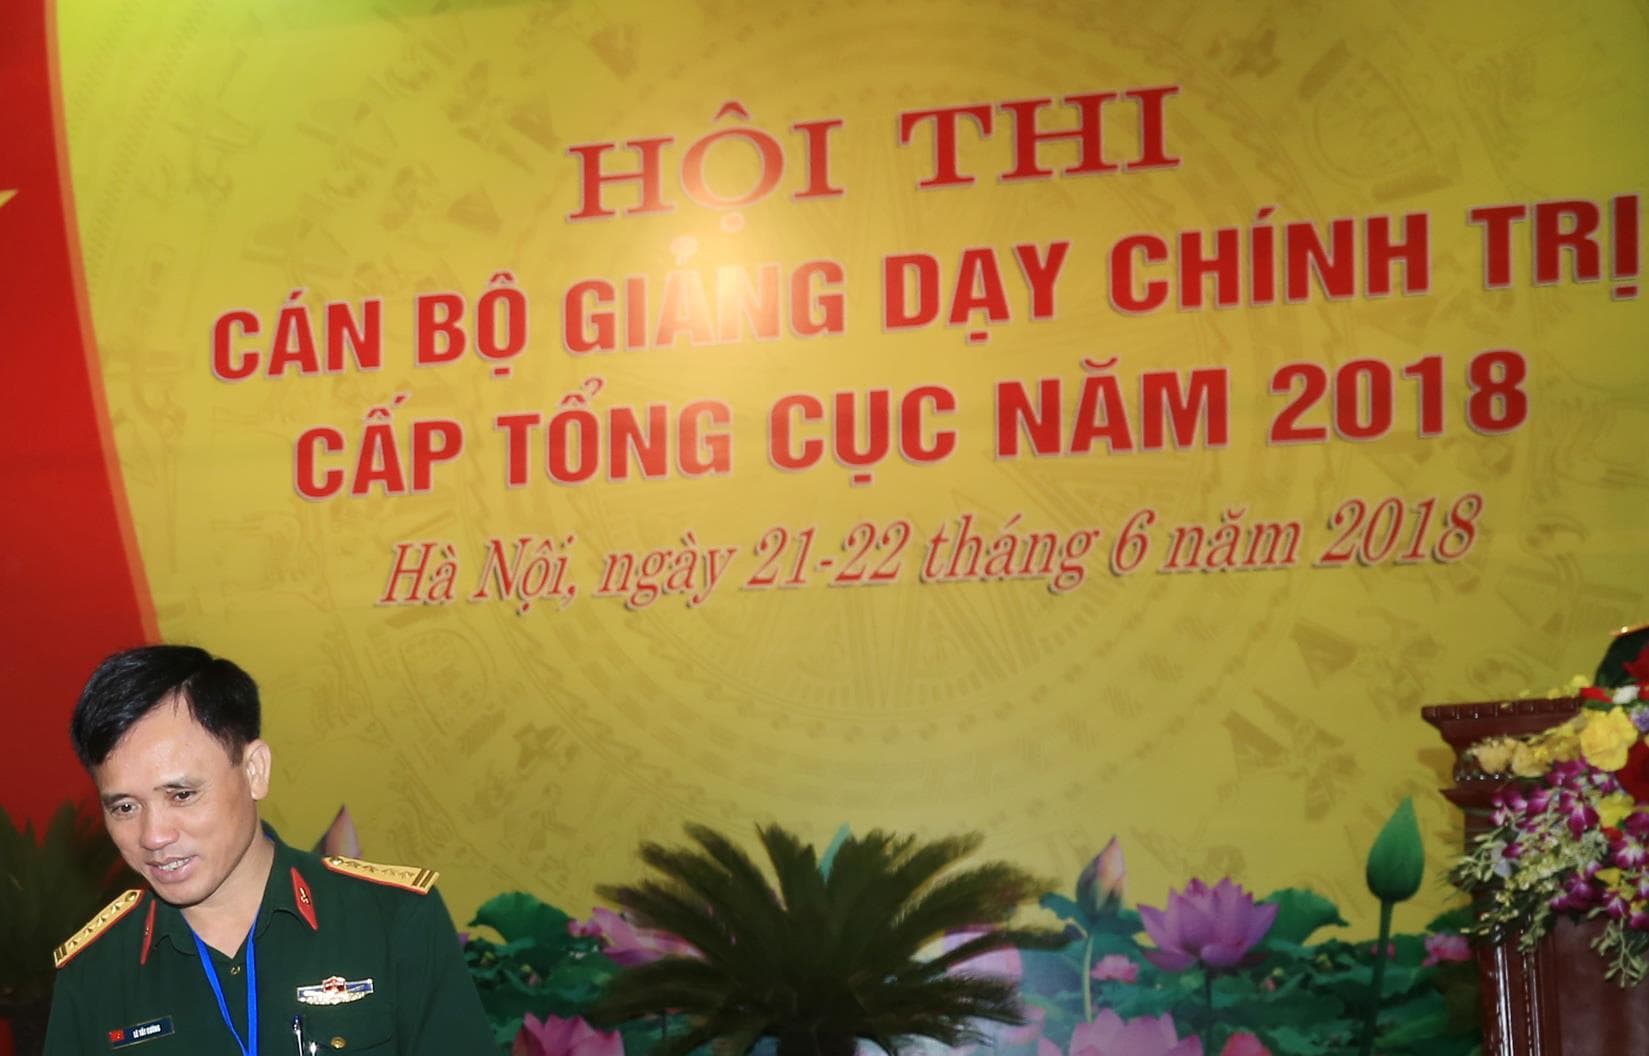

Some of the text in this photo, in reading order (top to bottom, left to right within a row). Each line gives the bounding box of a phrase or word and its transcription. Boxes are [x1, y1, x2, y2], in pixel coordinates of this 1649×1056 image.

[566, 85, 1180, 232] HỘI THI
[210, 192, 1641, 382] CÁN BỘ GIẢNG DẠY CHÍNH TRỊ
[293, 348, 1530, 501] CẤP TỔNG CỤC NĂM 2018
[379, 492, 1483, 617] Hà Nội, ngày 21-22 tháng 6 năm 2018
